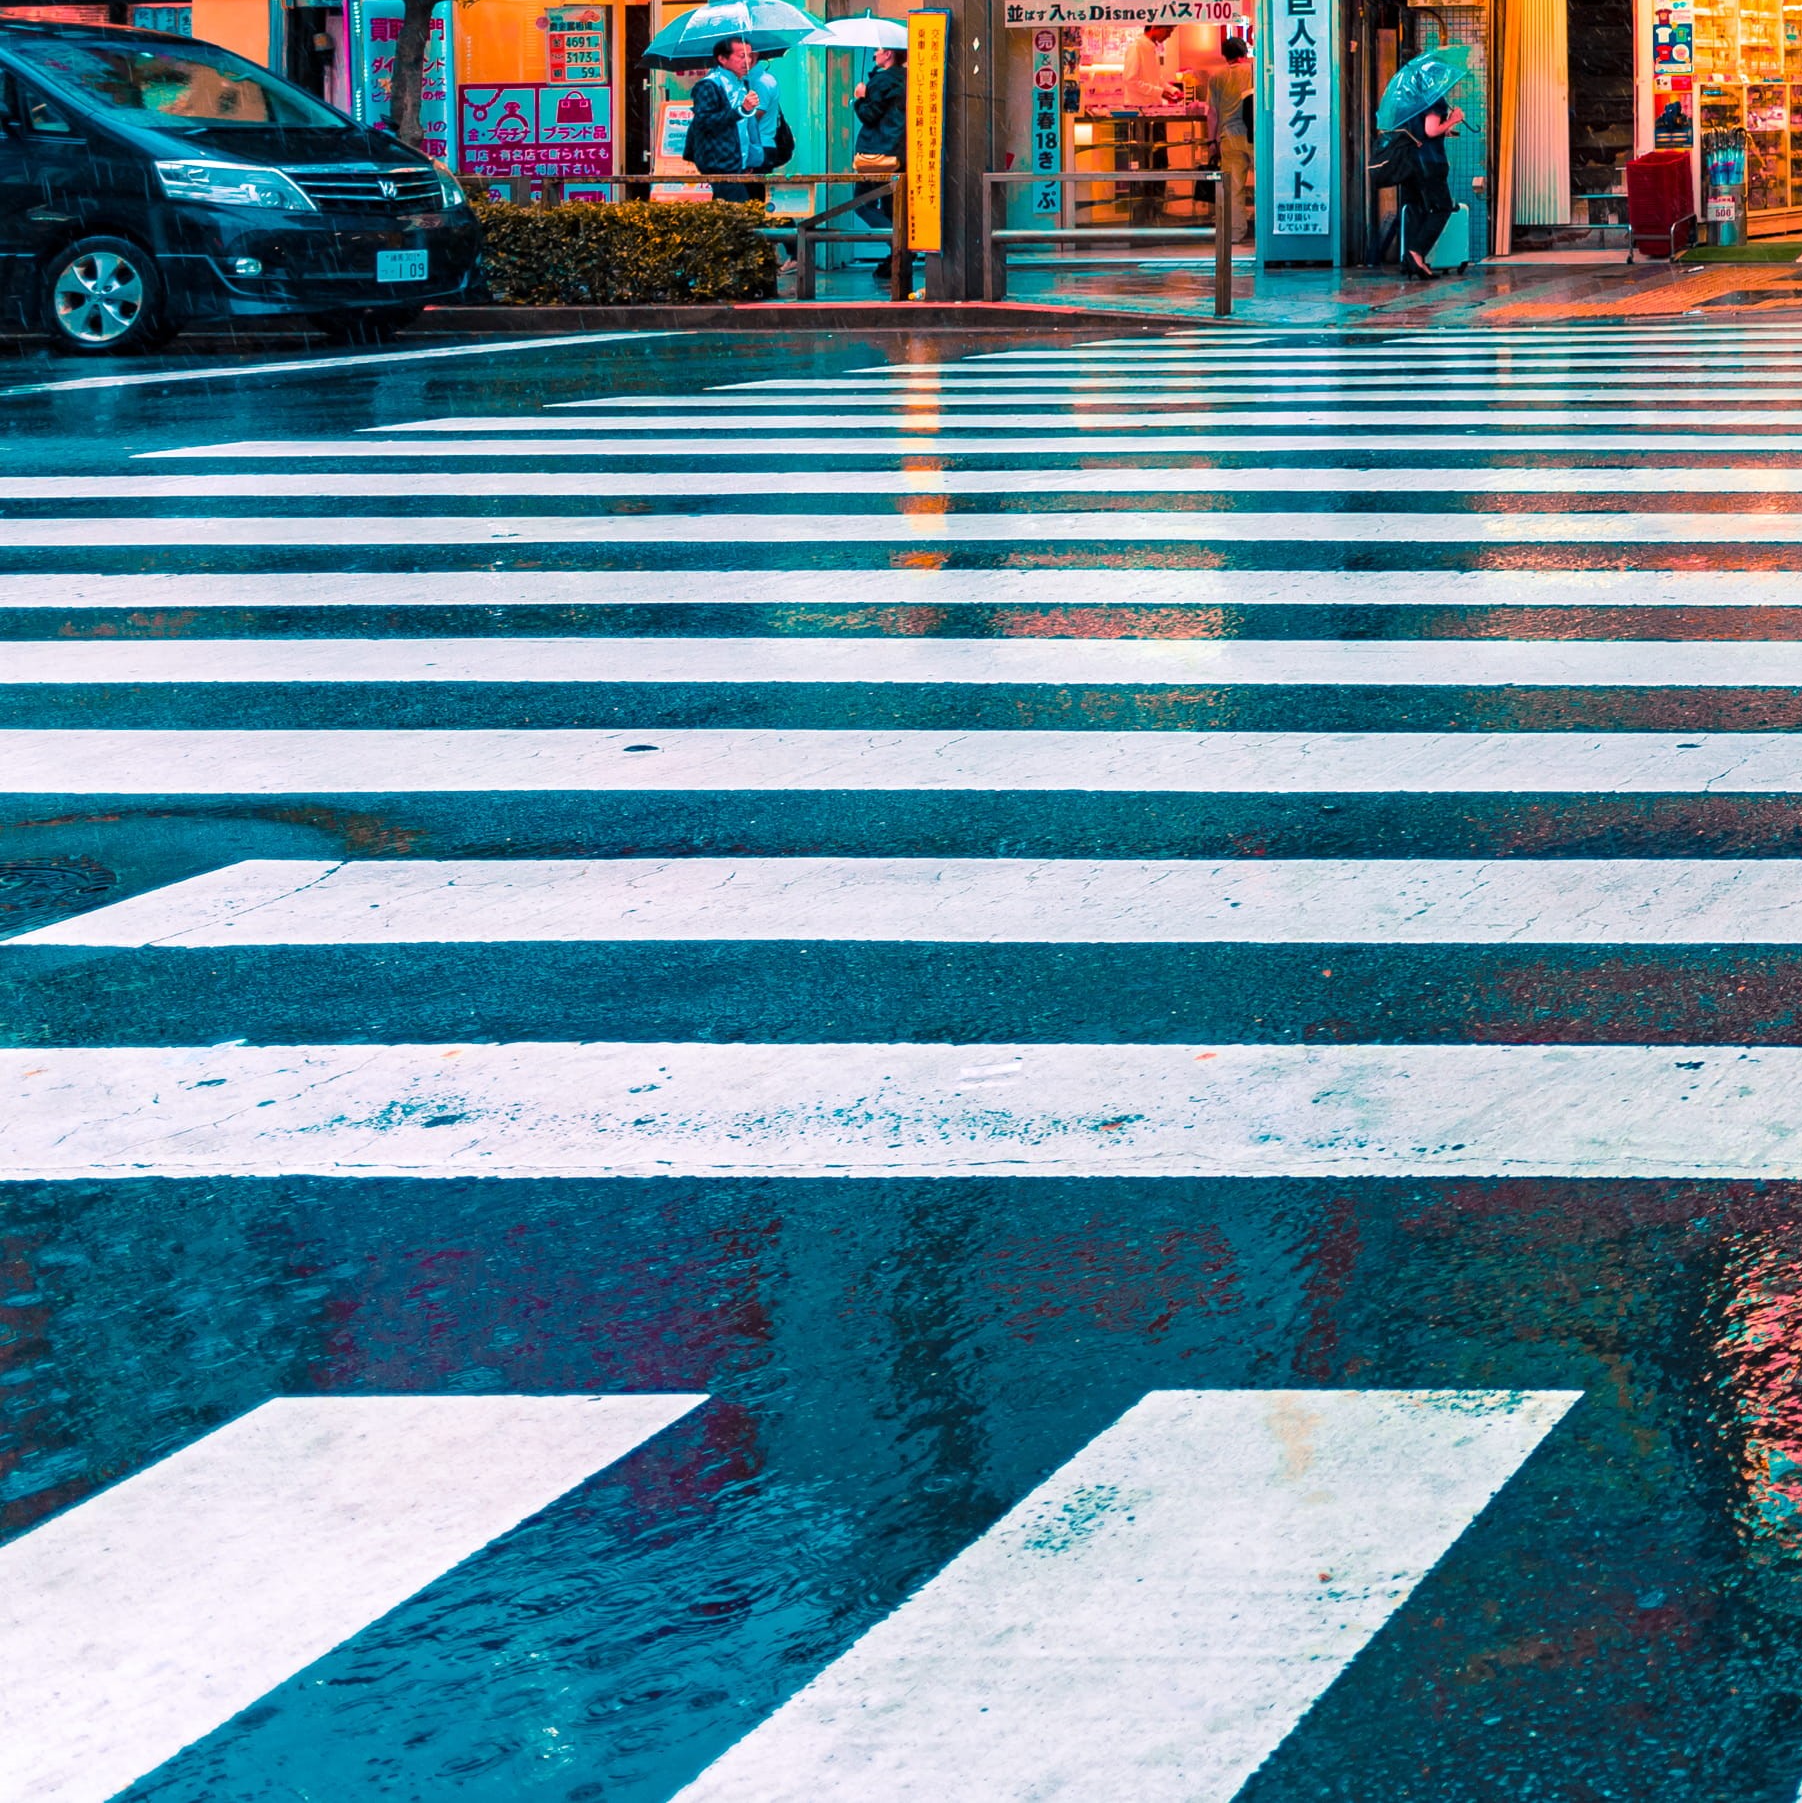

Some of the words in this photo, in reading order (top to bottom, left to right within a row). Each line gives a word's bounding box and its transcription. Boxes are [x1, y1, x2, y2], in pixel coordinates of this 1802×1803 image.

[543, 125, 607, 141] ブランド品
